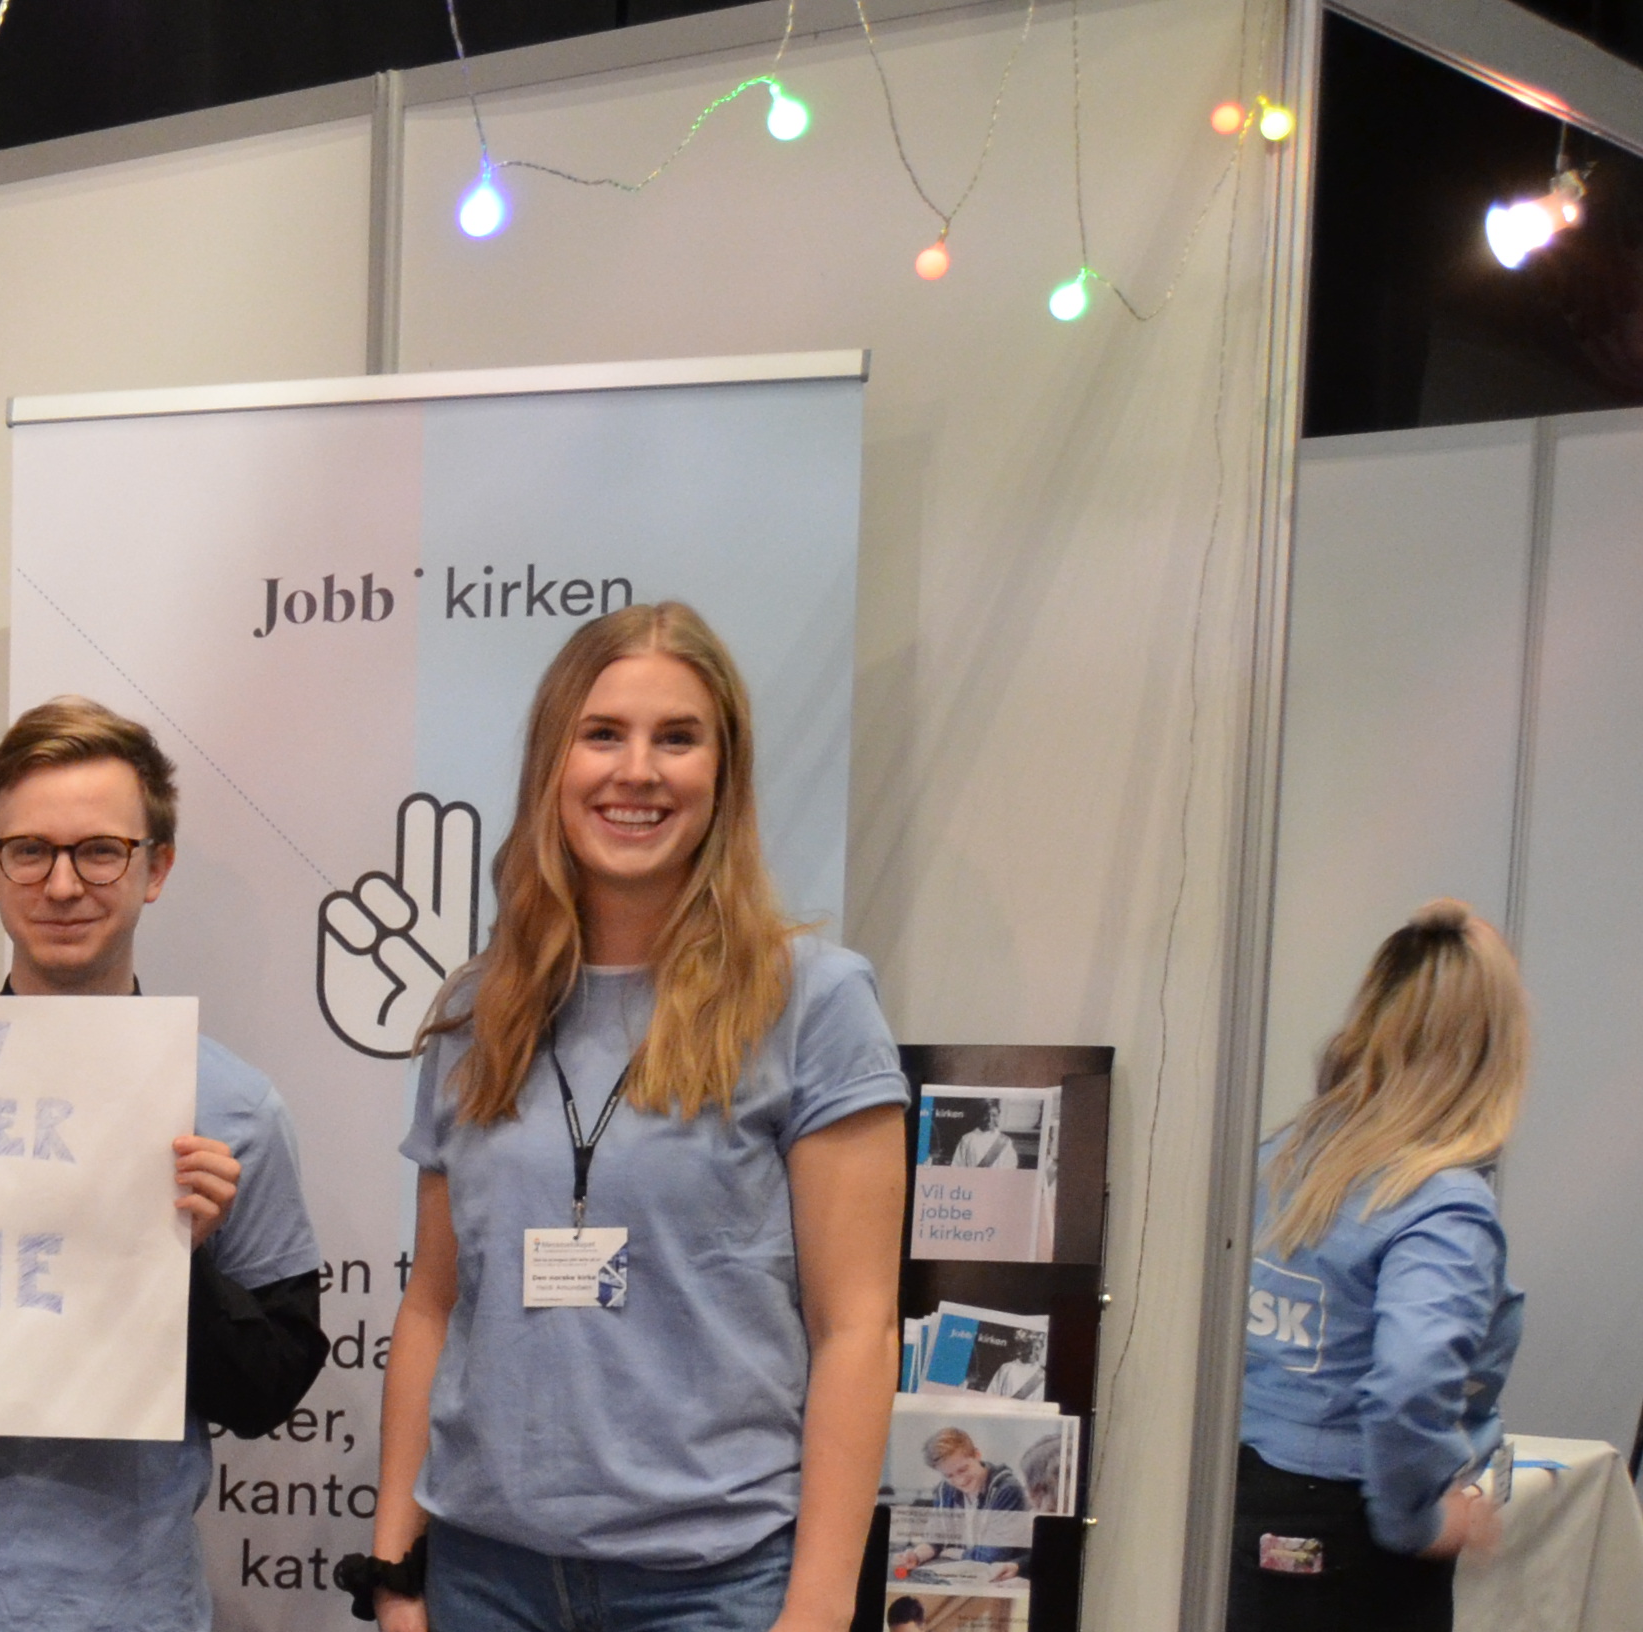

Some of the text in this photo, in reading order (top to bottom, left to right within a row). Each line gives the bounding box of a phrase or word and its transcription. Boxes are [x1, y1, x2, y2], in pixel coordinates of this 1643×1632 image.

[253, 564, 633, 639] Jobb kirken
[920, 1204, 972, 1222] jobbe
[922, 1185, 972, 1201] Vil du
[930, 1226, 995, 1242] kirken?
[1246, 1286, 1313, 1348] SK
[219, 1464, 378, 1518] kanto
[241, 1539, 354, 1590] kat
